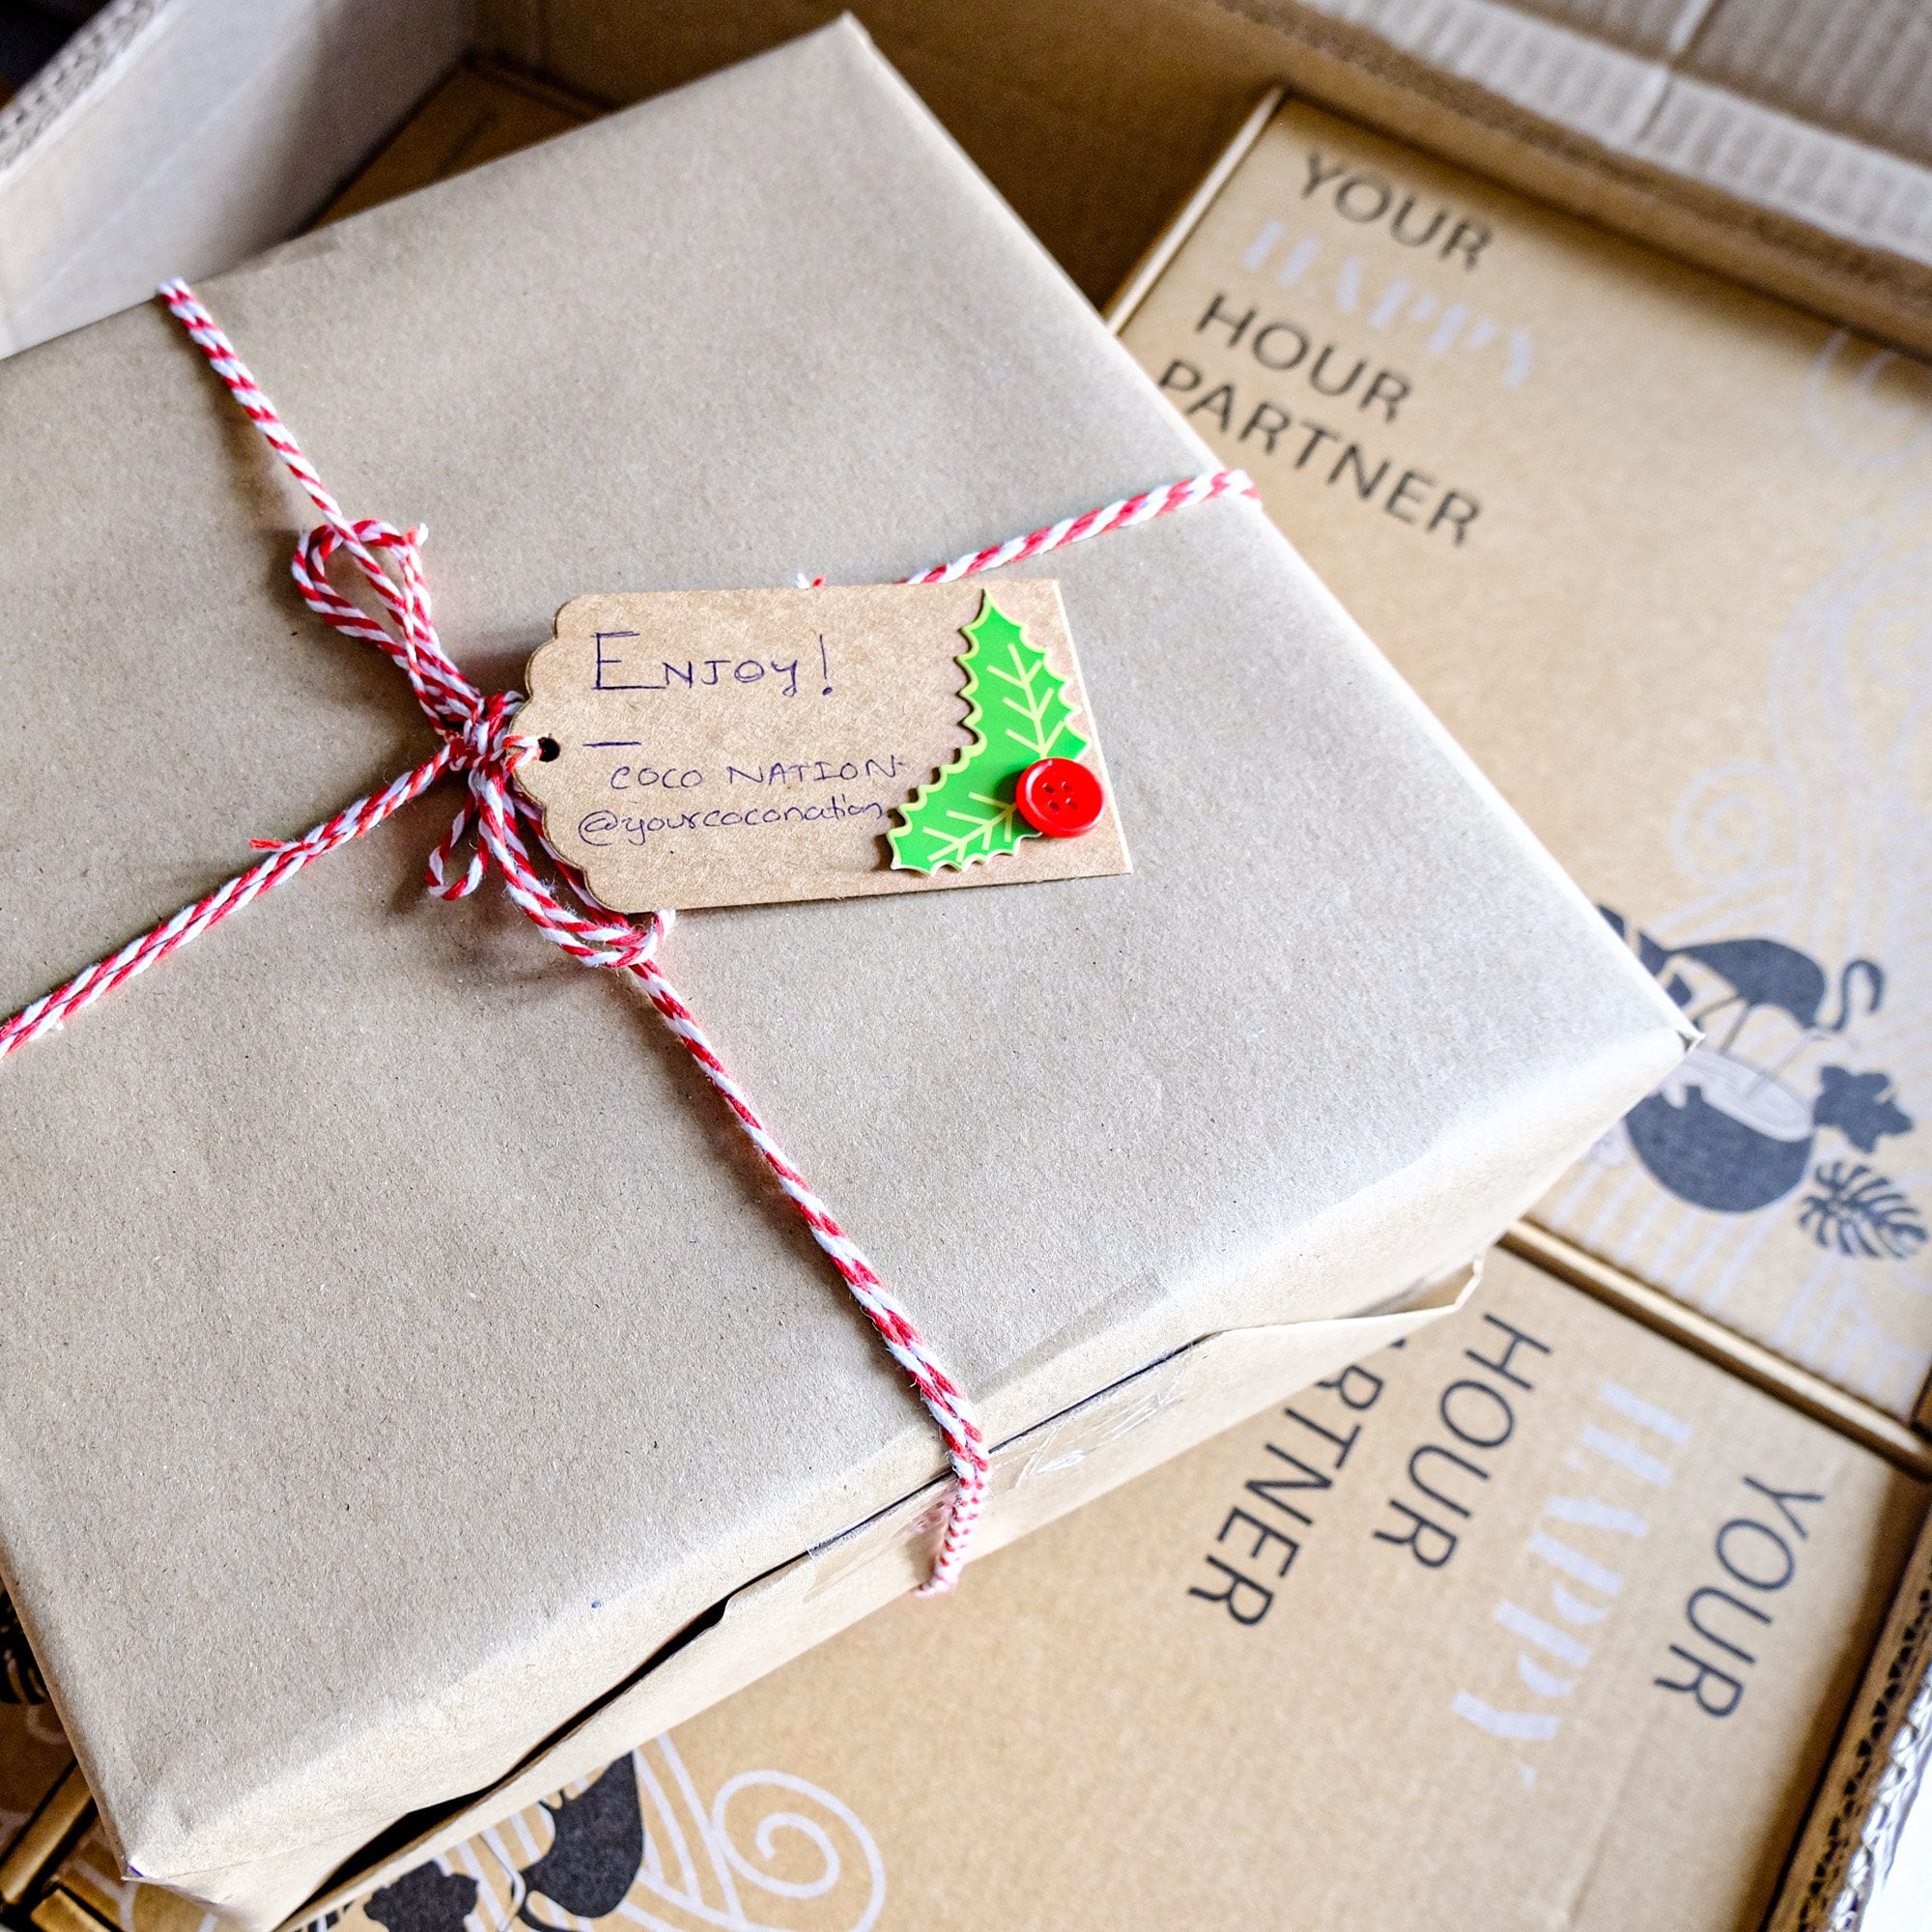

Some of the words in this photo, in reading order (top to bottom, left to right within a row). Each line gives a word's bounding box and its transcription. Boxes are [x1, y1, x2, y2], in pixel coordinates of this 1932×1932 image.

[1302, 152, 1492, 271] YOUR
[1159, 357, 1482, 546] PARTNER
[1195, 293, 1411, 423] HOUR
[579, 794, 884, 846] @yourcoconation
[1187, 1338, 1406, 1628] RTNER
[1373, 1313, 1553, 1571] HOUR
[1654, 1474, 1826, 1719] YOUR
